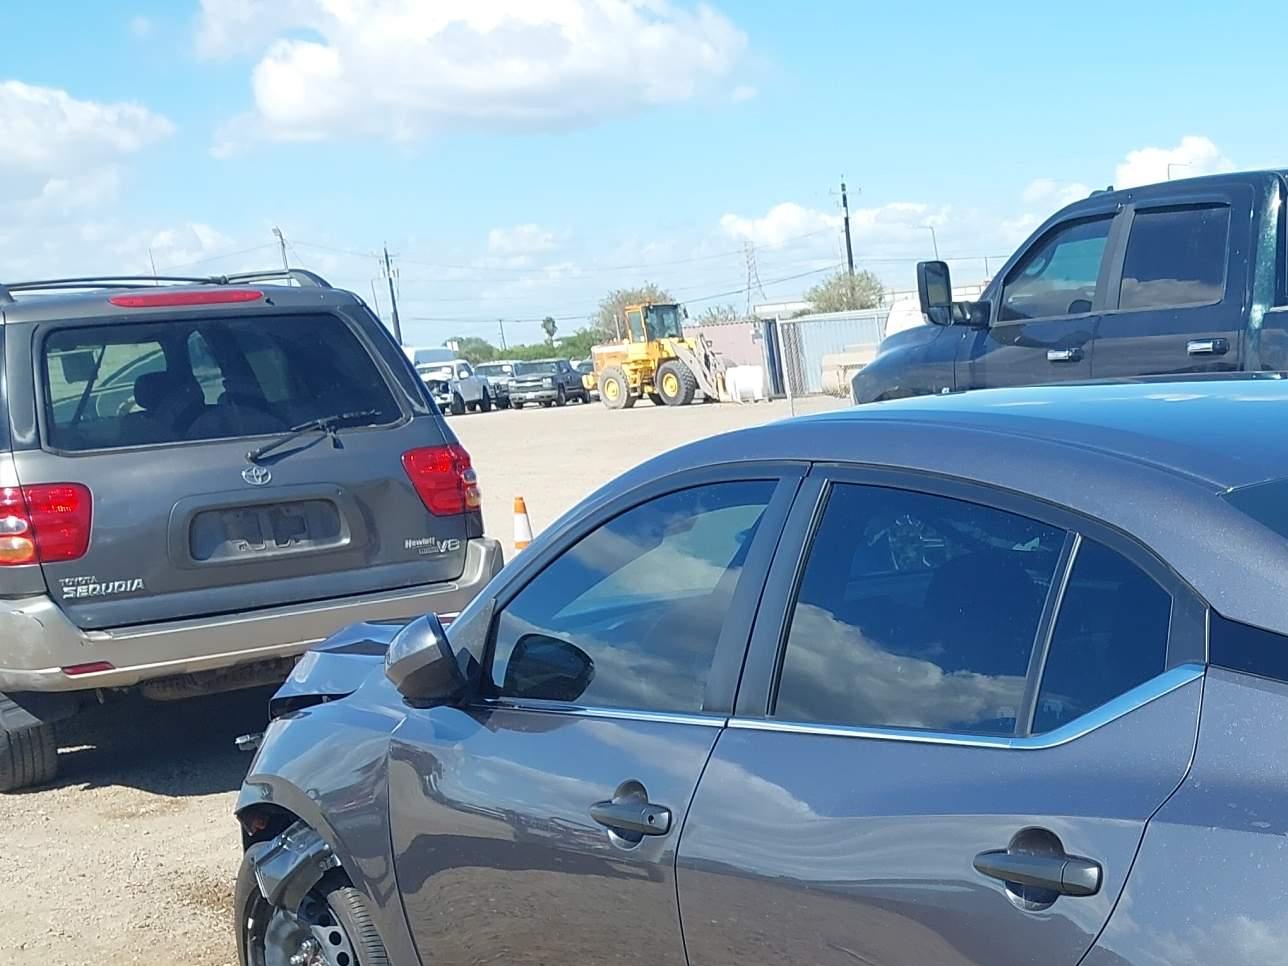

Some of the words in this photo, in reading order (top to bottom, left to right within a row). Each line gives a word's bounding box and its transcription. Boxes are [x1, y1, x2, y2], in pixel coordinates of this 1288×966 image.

[436, 538, 461, 553] V8
[59, 575, 98, 586] TOYOTA
[62, 578, 145, 600] SEQUOIA
